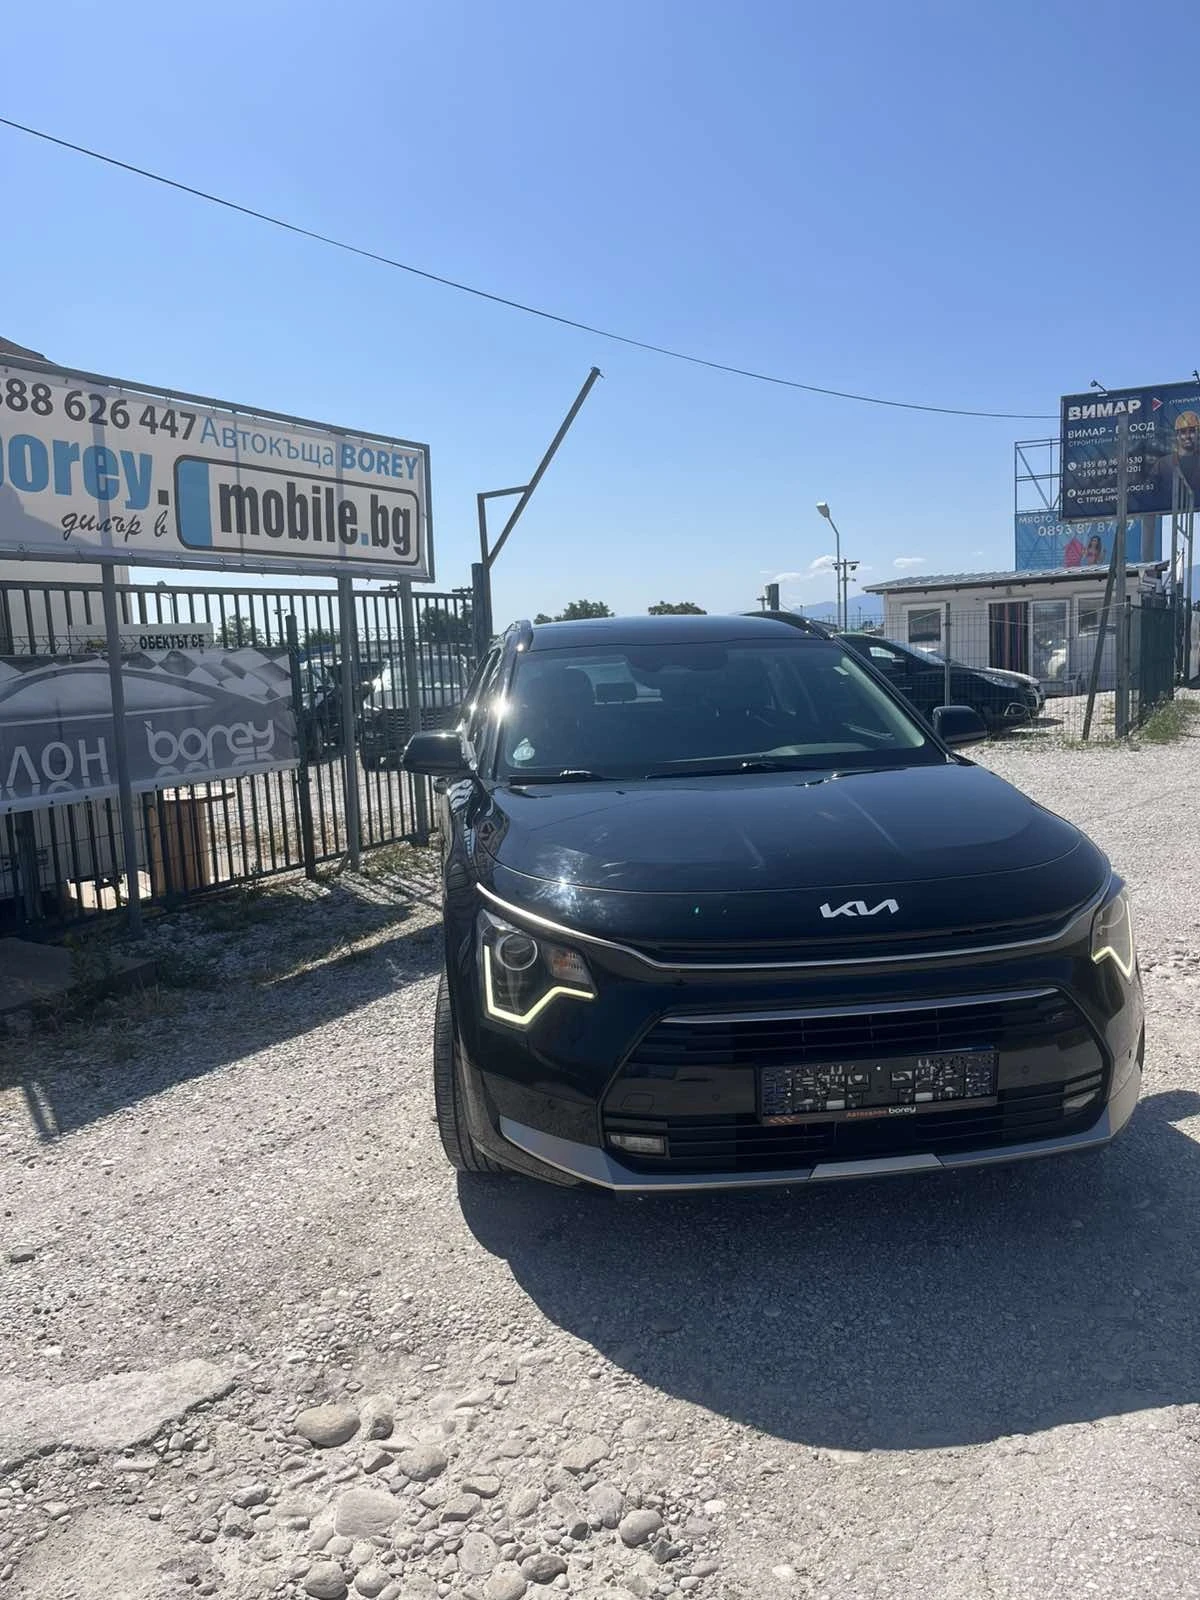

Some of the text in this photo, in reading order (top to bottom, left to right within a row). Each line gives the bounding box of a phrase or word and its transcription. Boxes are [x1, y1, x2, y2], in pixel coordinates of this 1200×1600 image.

[0, 378, 197, 440] 88 626 447
[1068, 400, 1141, 421] ВИМАР
[1068, 427, 1106, 439] ВИМАР
[1129, 422, 1155, 432] ООД
[200, 417, 419, 481] Автокъща BOREY
[0, 433, 169, 511] orey.
[61, 510, 143, 542] дилър
[218, 480, 411, 556] mobile.bg
[1038, 524, 1072, 536] 0893
[1076, 522, 1092, 534] 87
[139, 633, 205, 650] ОБЕКТЪТ СЕ
[144, 719, 275, 766] borey
[0, 737, 109, 787] ЛОН
[820, 899, 899, 918] KIA
[888, 1106, 916, 1114] borey
